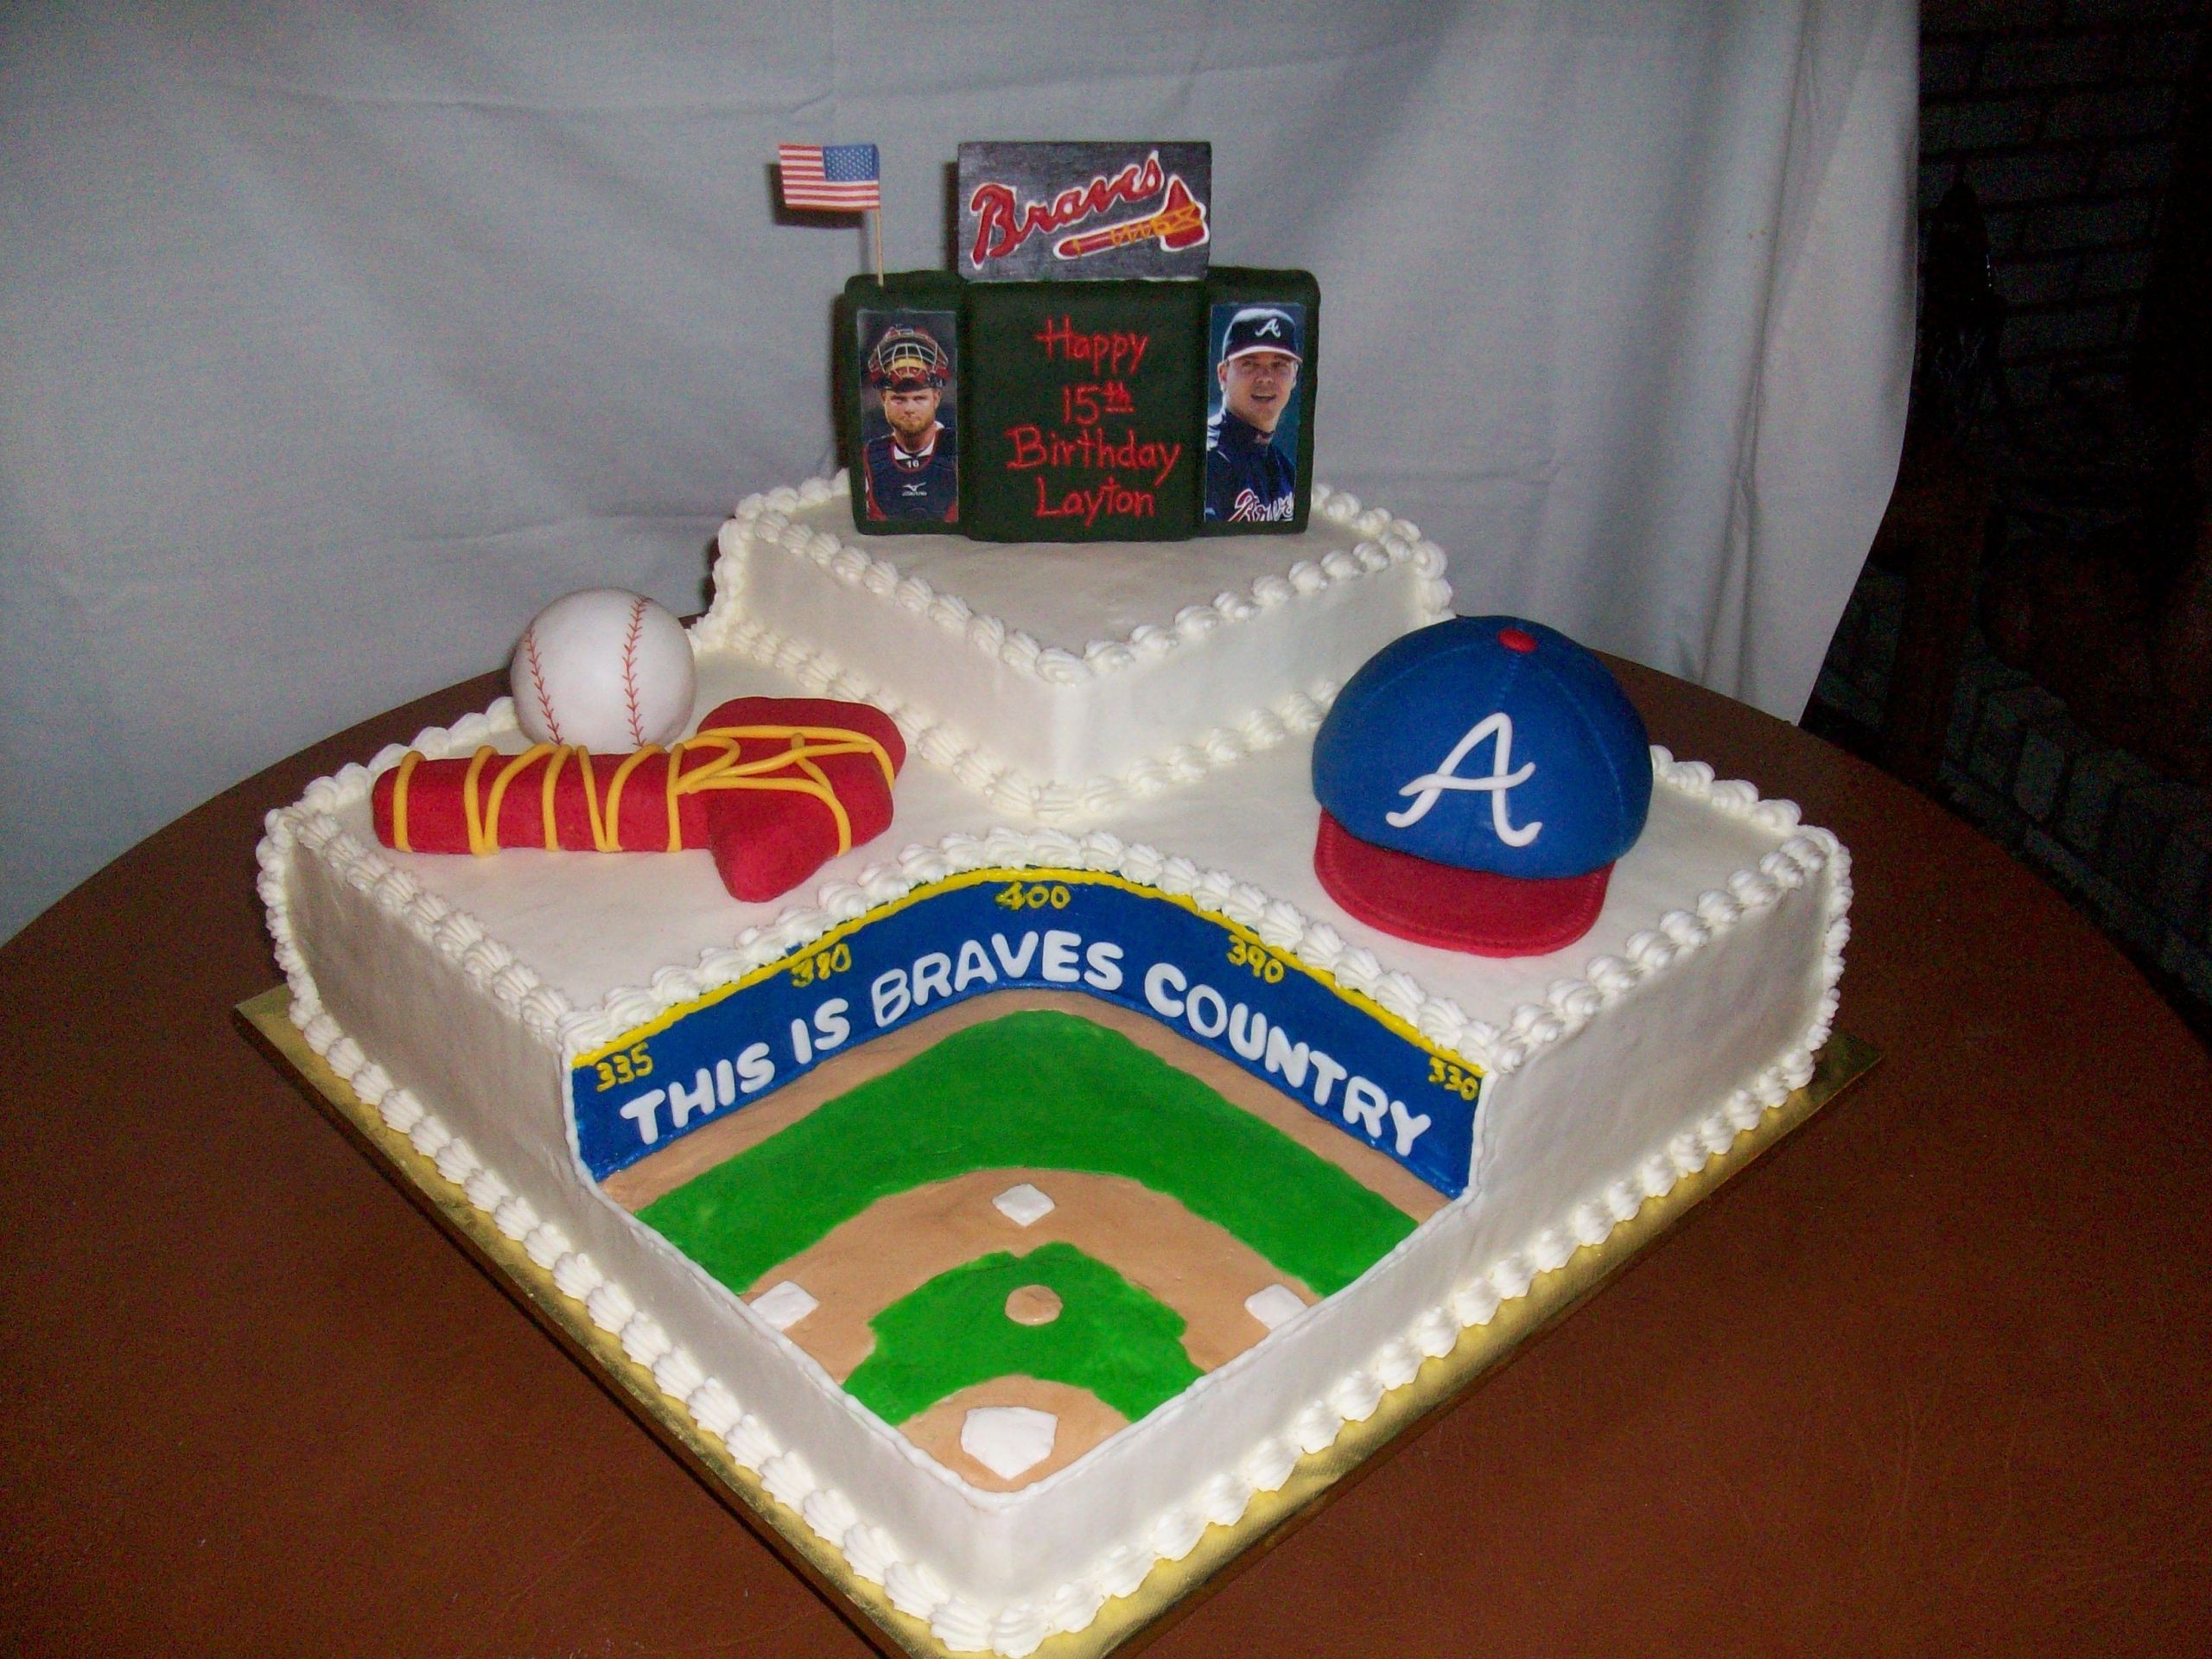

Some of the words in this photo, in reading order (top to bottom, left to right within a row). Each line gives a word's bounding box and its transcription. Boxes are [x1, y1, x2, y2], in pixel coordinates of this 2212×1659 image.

[970, 150, 1164, 270] Braves
[1036, 315, 1150, 376] Happy
[1062, 379, 1135, 425] 15th
[1005, 424, 1182, 489] Birthday
[1034, 476, 1156, 530] Layton
[1386, 713, 1542, 847] A
[995, 881, 1071, 912] 400
[1227, 934, 1285, 983] 390
[595, 1041, 653, 1092] 335
[620, 1043, 776, 1144] THIS
[791, 998, 850, 1064] IS
[871, 930, 1123, 1027] BRAVES
[1144, 963, 1432, 1156] COUNTRY
[1427, 1056, 1478, 1102] 330
